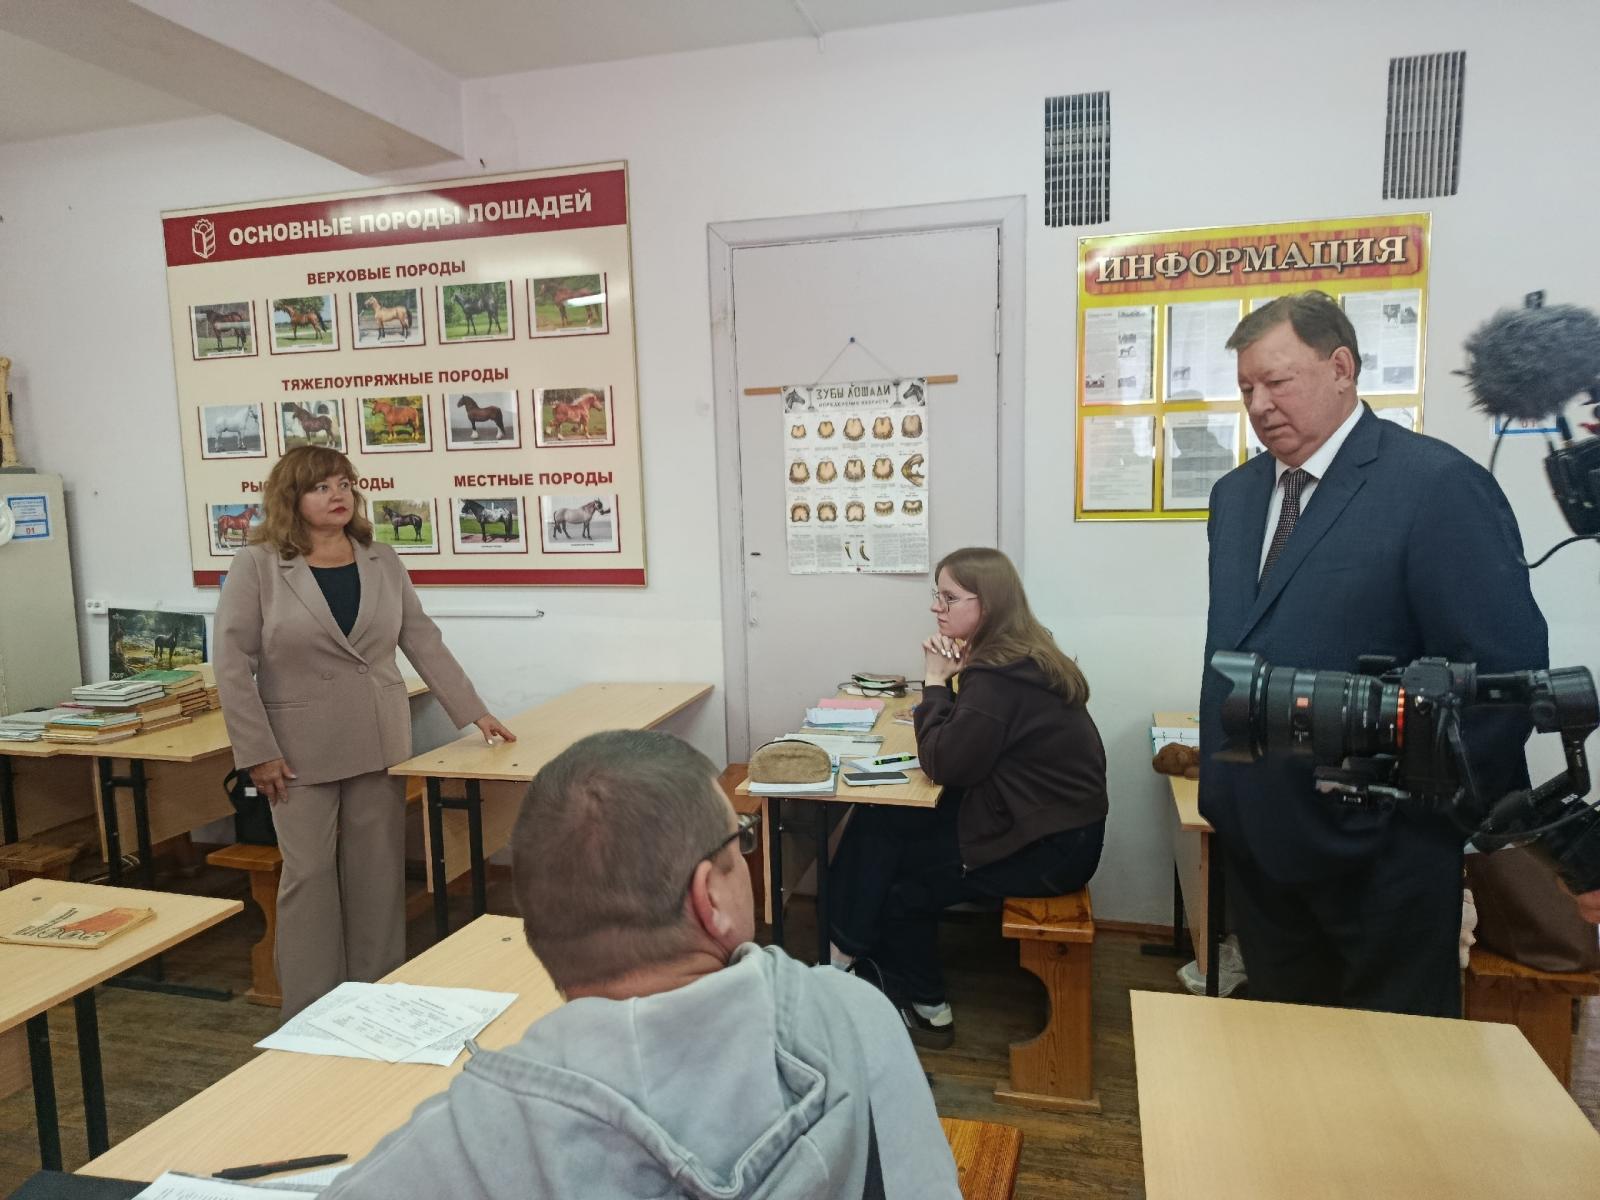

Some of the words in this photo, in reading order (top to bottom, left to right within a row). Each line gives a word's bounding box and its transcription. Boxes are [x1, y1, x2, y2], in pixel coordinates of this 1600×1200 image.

[228, 217, 353, 246] ОСНОВНЫЕ
[359, 207, 461, 233] ПОРОДЫ
[467, 188, 592, 223] ЛОШАДЕЙ
[1095, 235, 1408, 283] ИНФОРМАЦИЯ
[307, 266, 391, 285] ВЕРХОВЫЕ
[396, 260, 465, 278] ПОРОДЫ
[282, 371, 434, 391] ТЯЖЕЛОУПРЯЖНЫЕ
[439, 367, 509, 383] ПОРОДЫ
[816, 387, 844, 400] ЗУБЫ
[847, 384, 890, 398] ЛОШАДИ
[352, 477, 394, 491] РОДЫ
[454, 473, 534, 487] МЕСТНЫЕ
[539, 471, 613, 486] ПОРОДЫ
